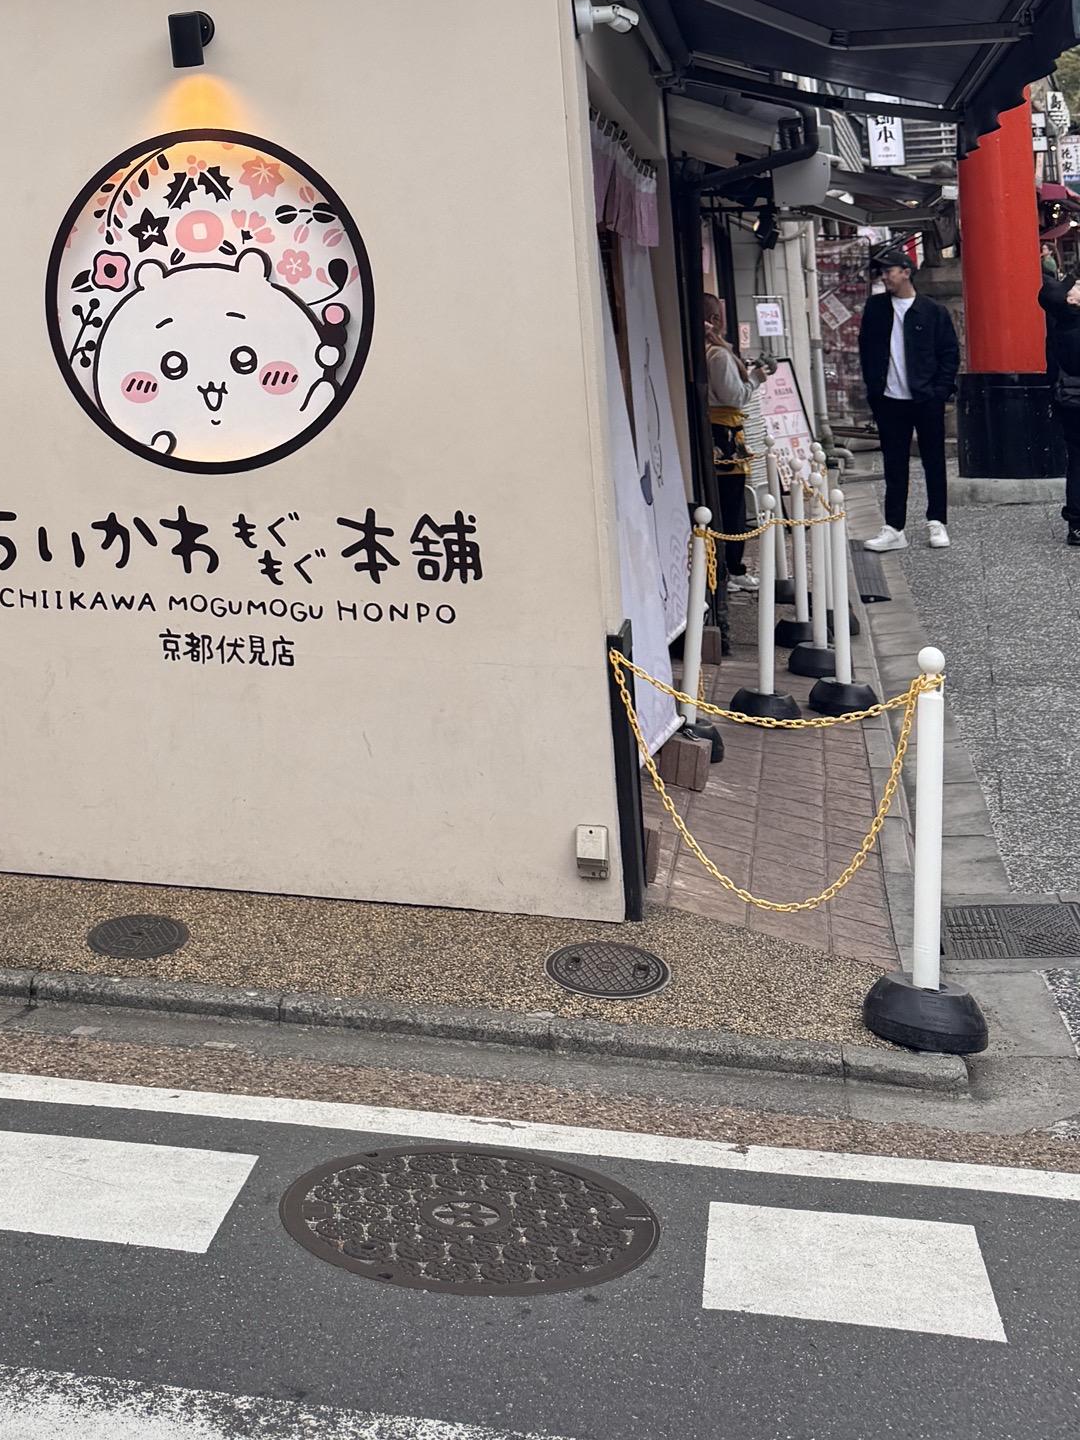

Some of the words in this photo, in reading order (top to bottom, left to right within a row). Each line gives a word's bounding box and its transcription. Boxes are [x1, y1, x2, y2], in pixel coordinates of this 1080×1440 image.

[167, 592, 324, 622] MOGUMOGU
[337, 600, 457, 625] HONPO
[159, 629, 296, 666] 京都伏見店
